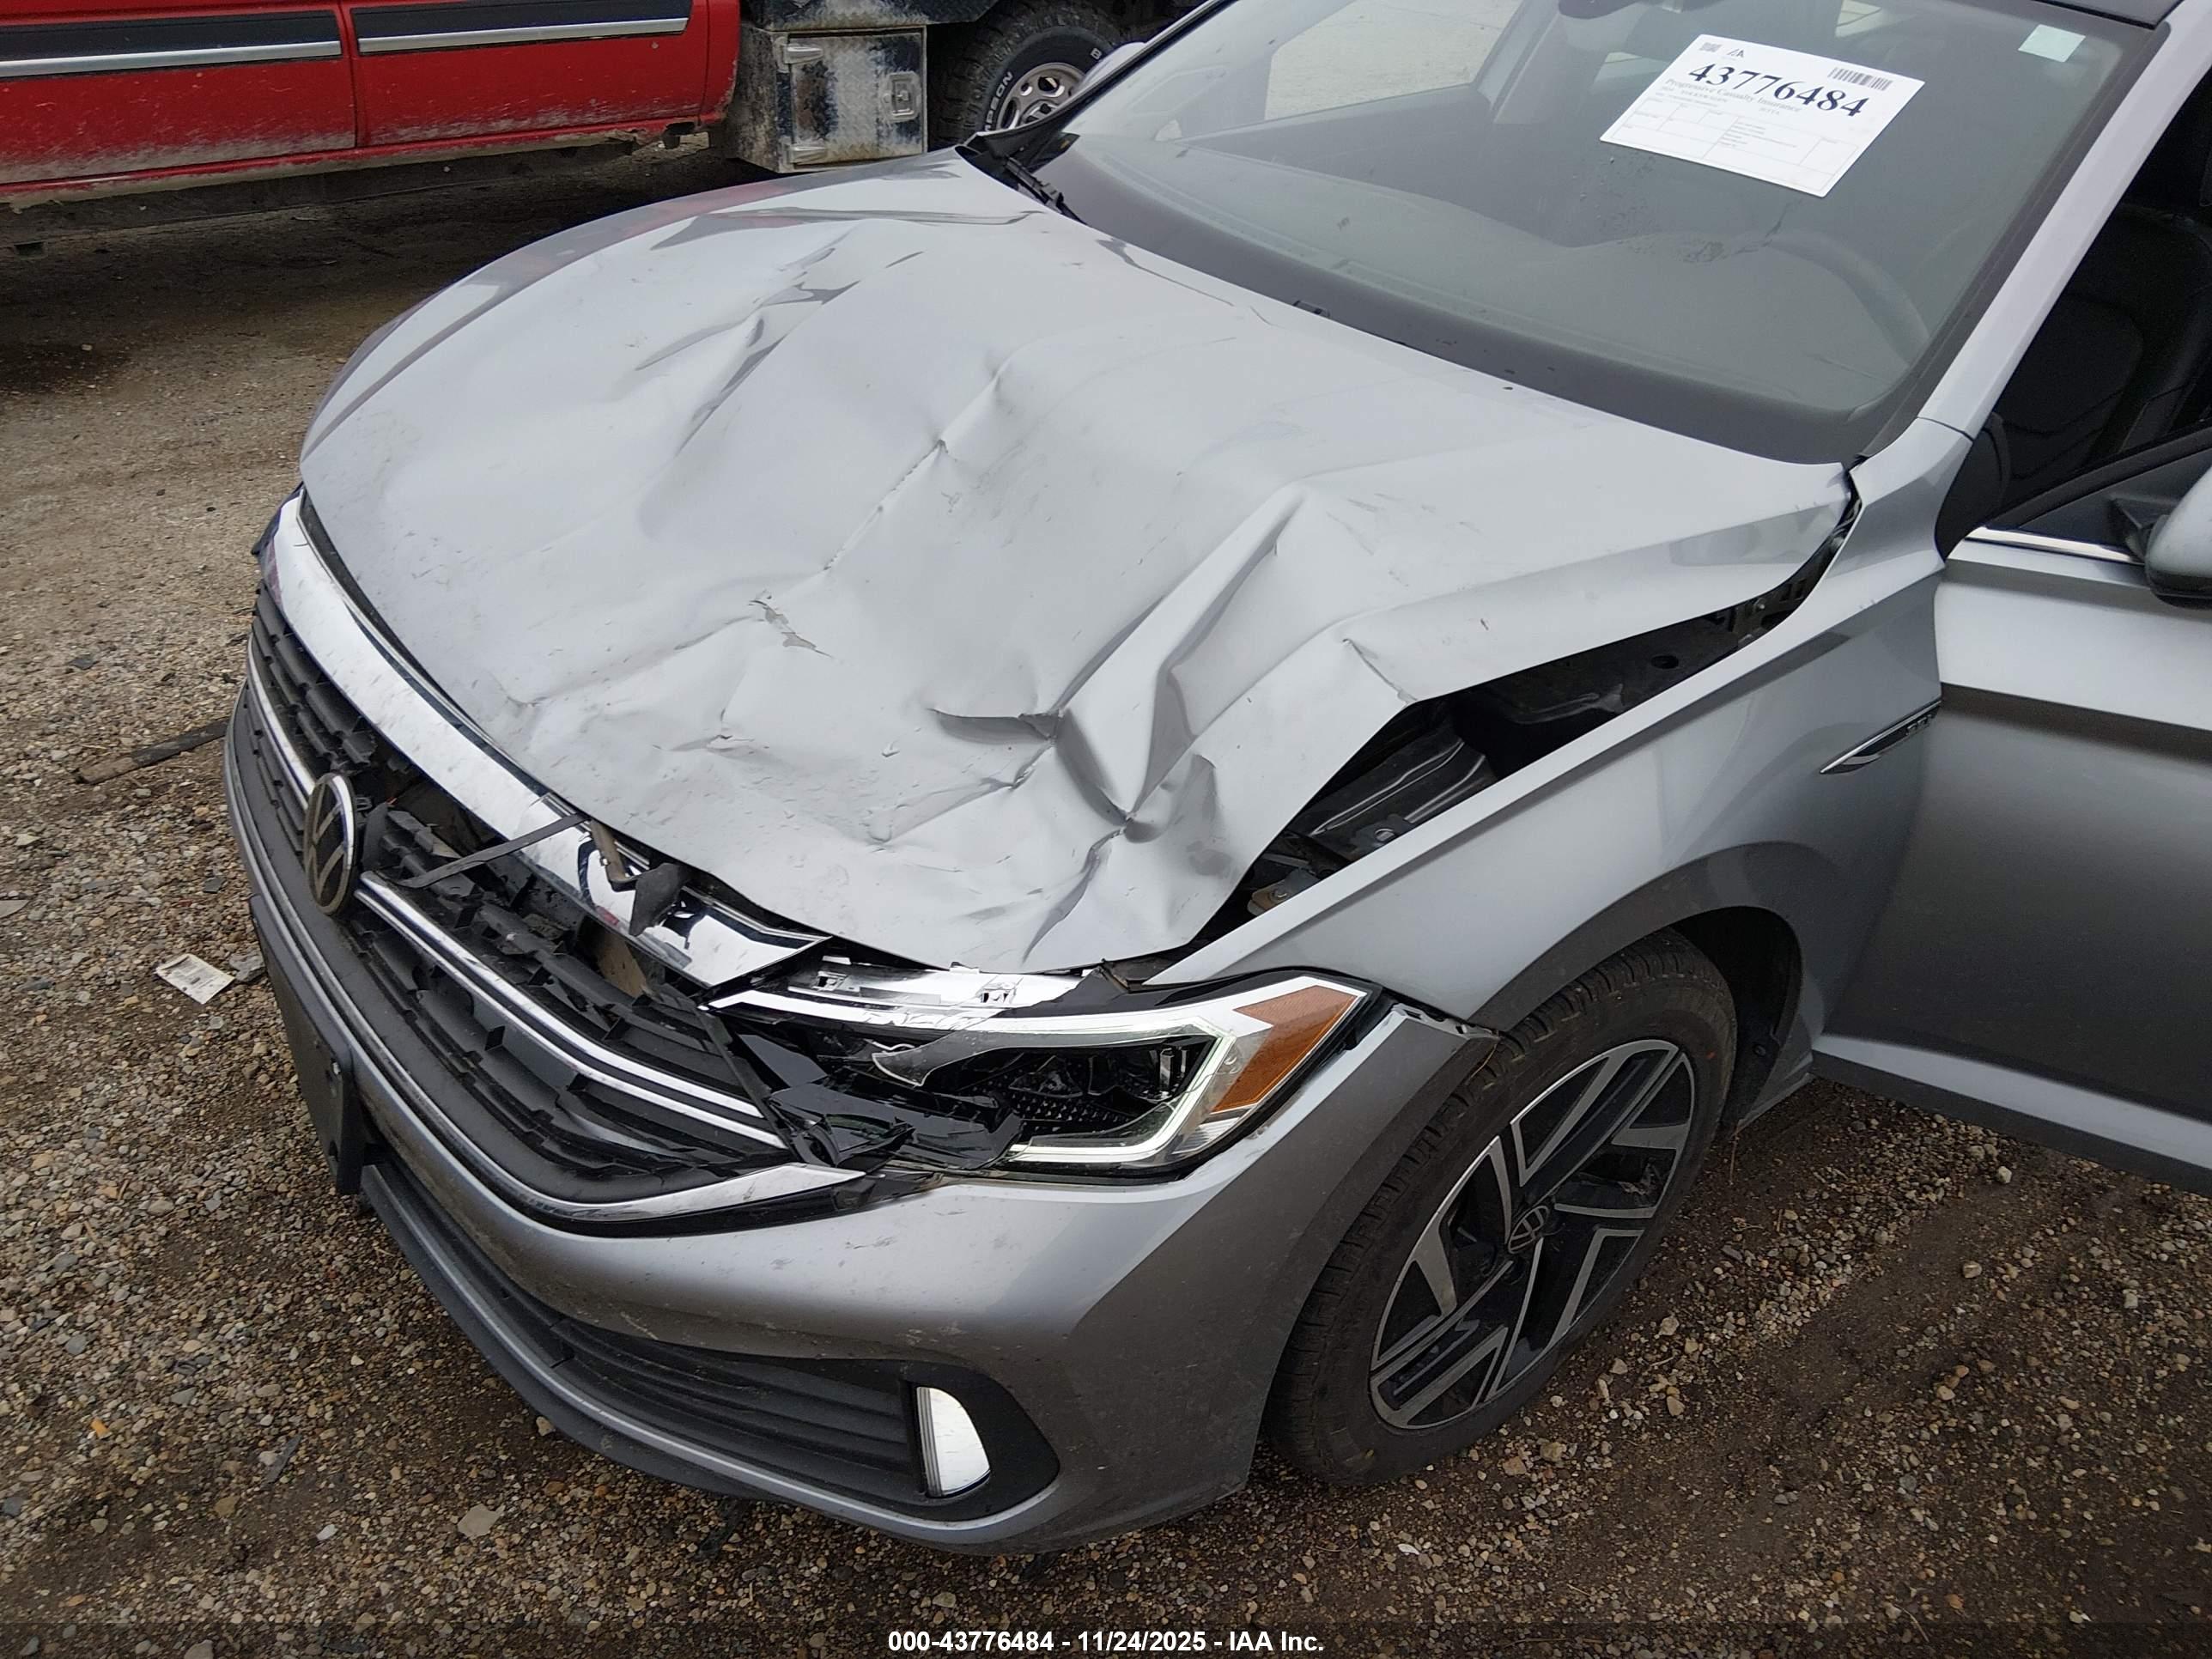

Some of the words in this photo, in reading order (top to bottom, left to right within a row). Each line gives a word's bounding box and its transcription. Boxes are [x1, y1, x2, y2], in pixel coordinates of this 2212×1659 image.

[1665, 78, 1717, 94] Progressive
[1717, 88, 1754, 103] Casualty
[1757, 96, 1802, 112] Insurance
[1688, 64, 1870, 118] 43776484
